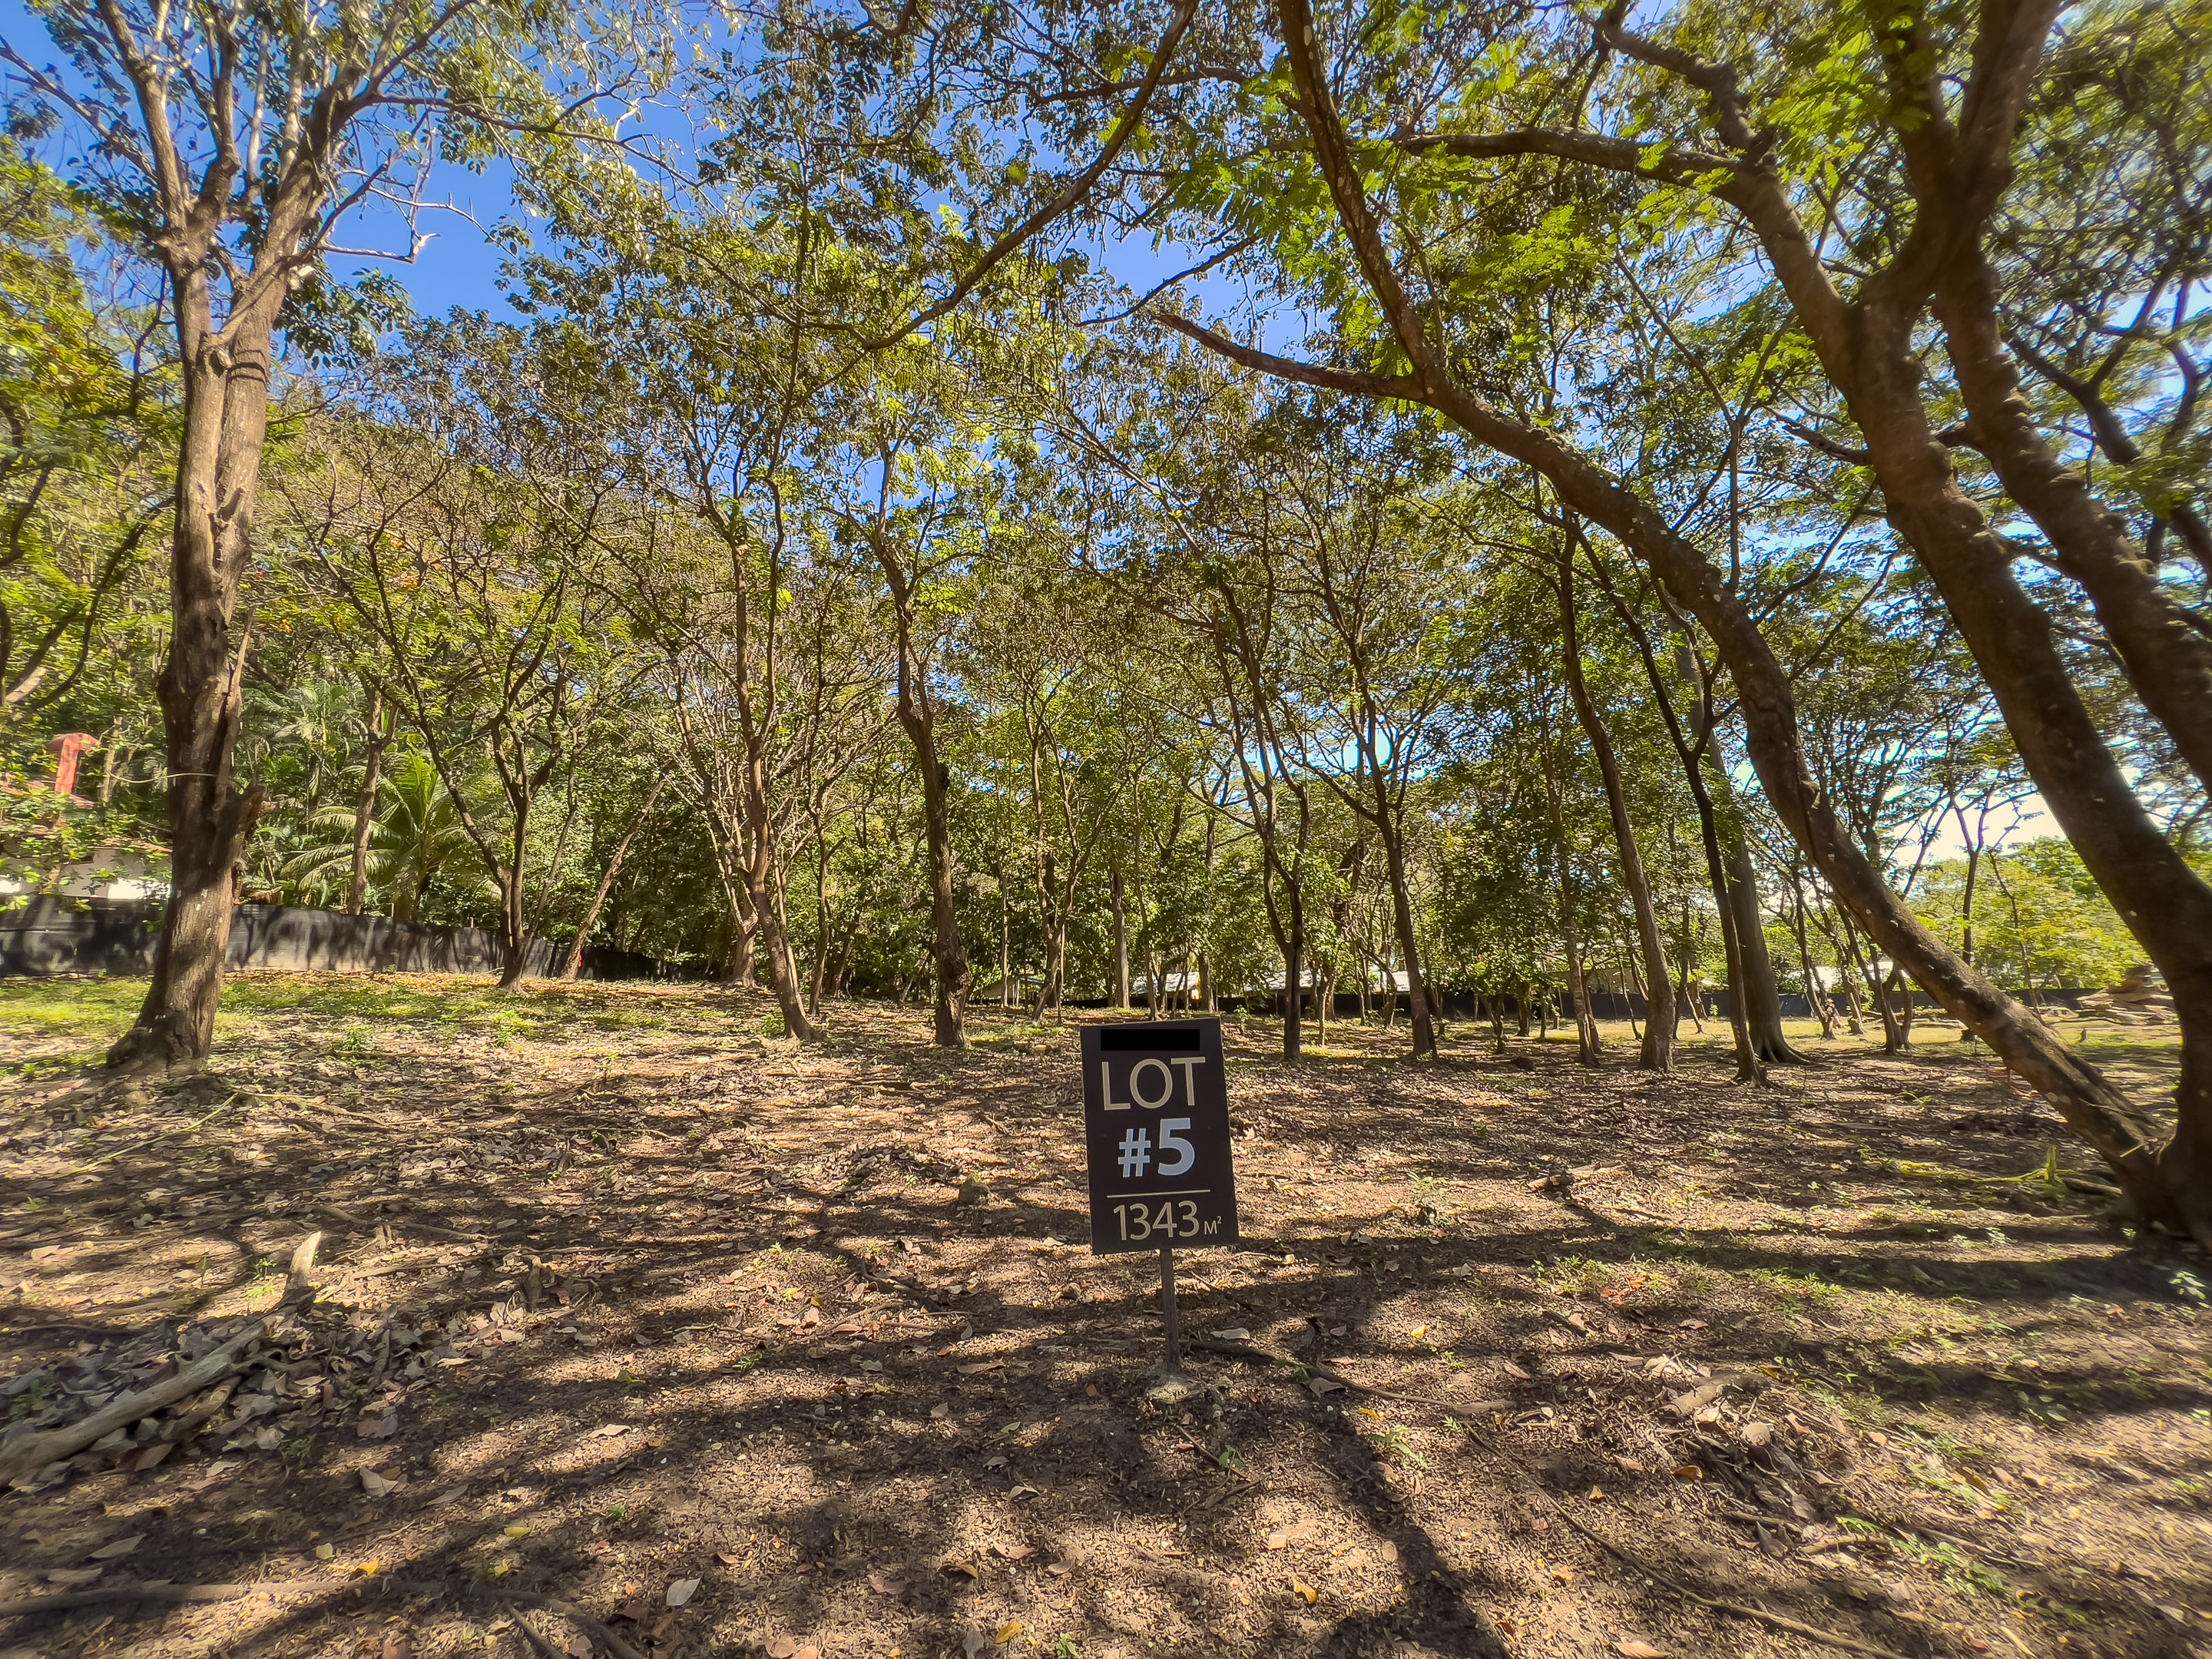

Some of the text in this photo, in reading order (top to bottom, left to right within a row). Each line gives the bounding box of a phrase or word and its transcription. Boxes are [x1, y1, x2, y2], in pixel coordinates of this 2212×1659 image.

[1102, 1057, 1206, 1111] LOT
[1118, 1118, 1196, 1177] #5
[1113, 1200, 1200, 1240] 1343
